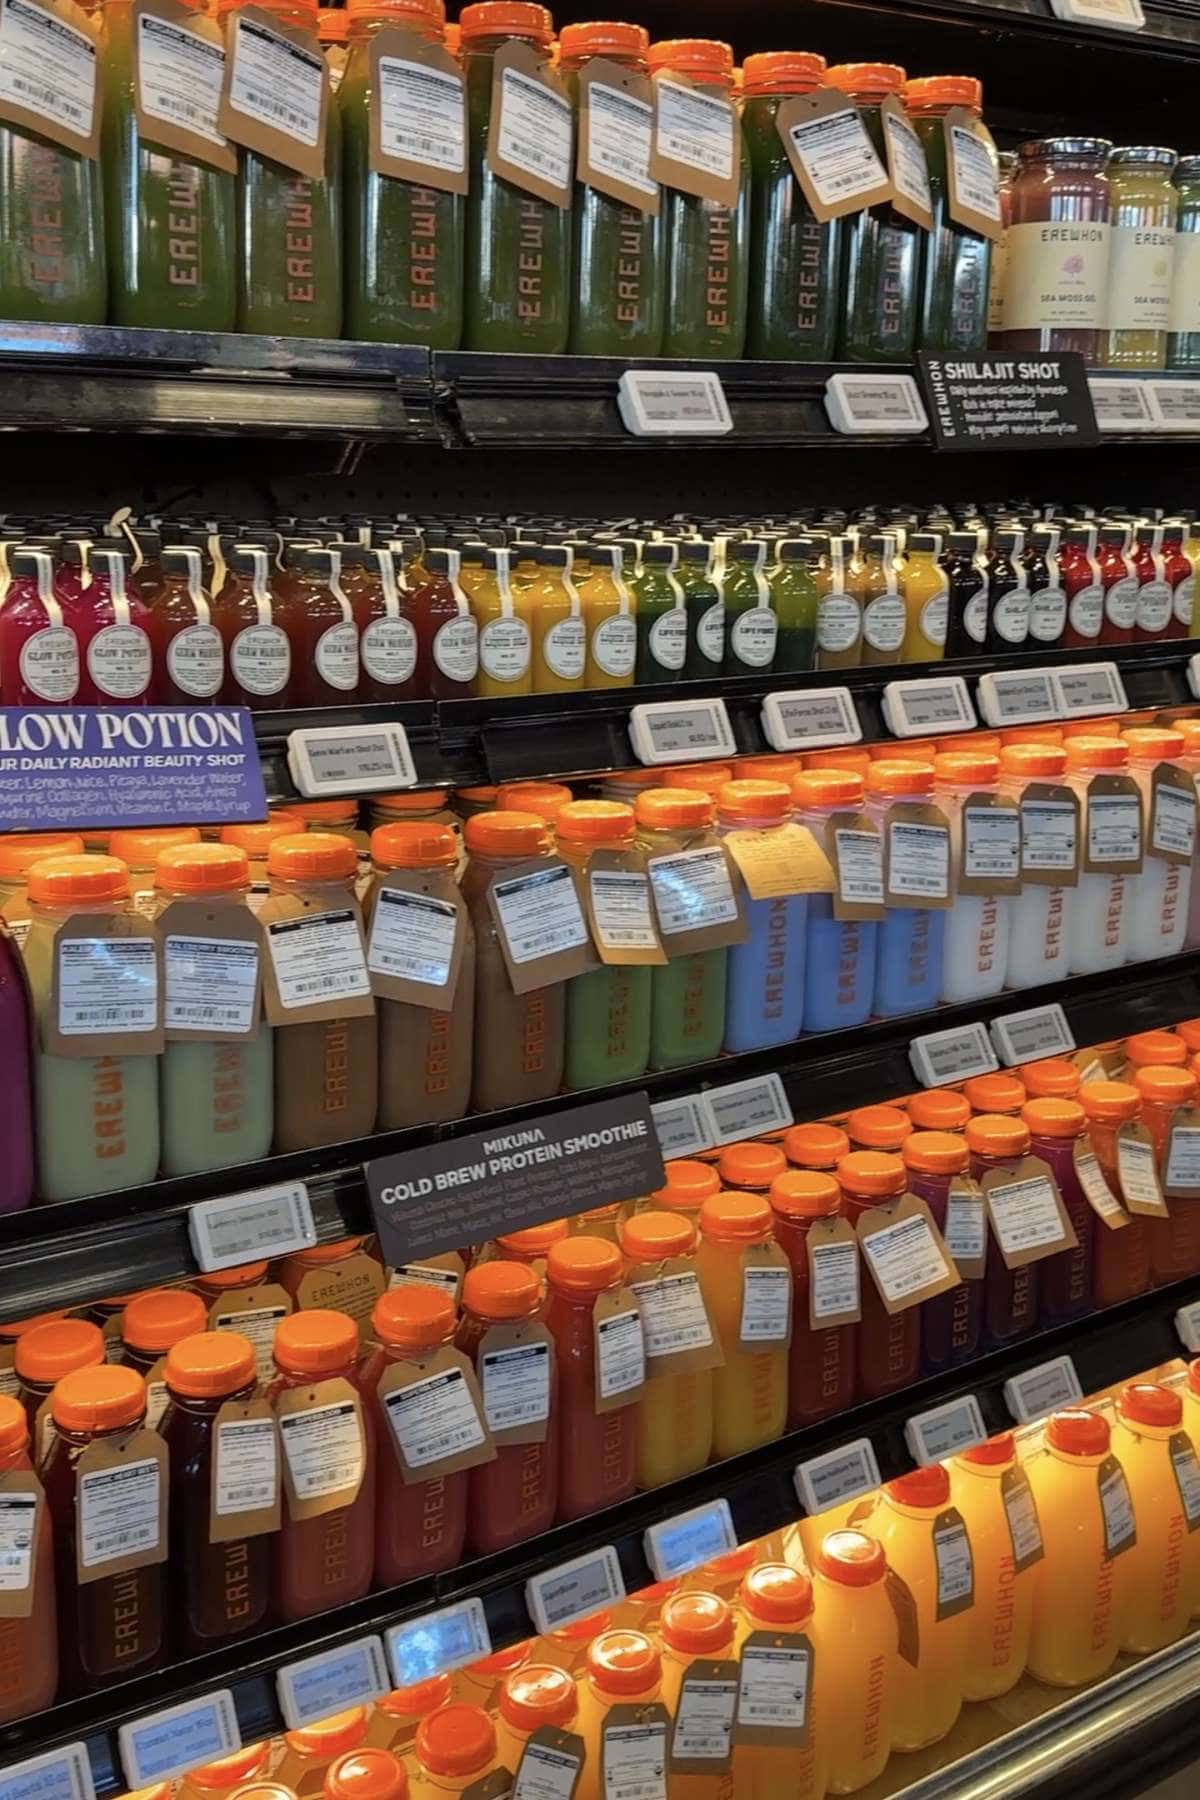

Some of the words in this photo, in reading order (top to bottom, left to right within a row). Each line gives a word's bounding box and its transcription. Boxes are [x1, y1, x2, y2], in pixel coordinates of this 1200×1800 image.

[944, 363, 1014, 380] SHILAJIT
[1018, 363, 1060, 380] SHOT
[928, 360, 956, 437] EREWHON
[96, 712, 243, 749] POTION
[21, 757, 68, 770] DAILY
[69, 756, 140, 770] RADIANT
[144, 755, 203, 768] BEAUTY
[207, 754, 246, 766] SHOT
[483, 1128, 545, 1155] MIKUNA
[381, 1178, 432, 1204] COLD
[435, 1162, 486, 1190] BREW
[489, 1142, 563, 1175] PROTEIN
[563, 1120, 648, 1155] SMOOTHIE
[225, 1544, 248, 1618] EREW
